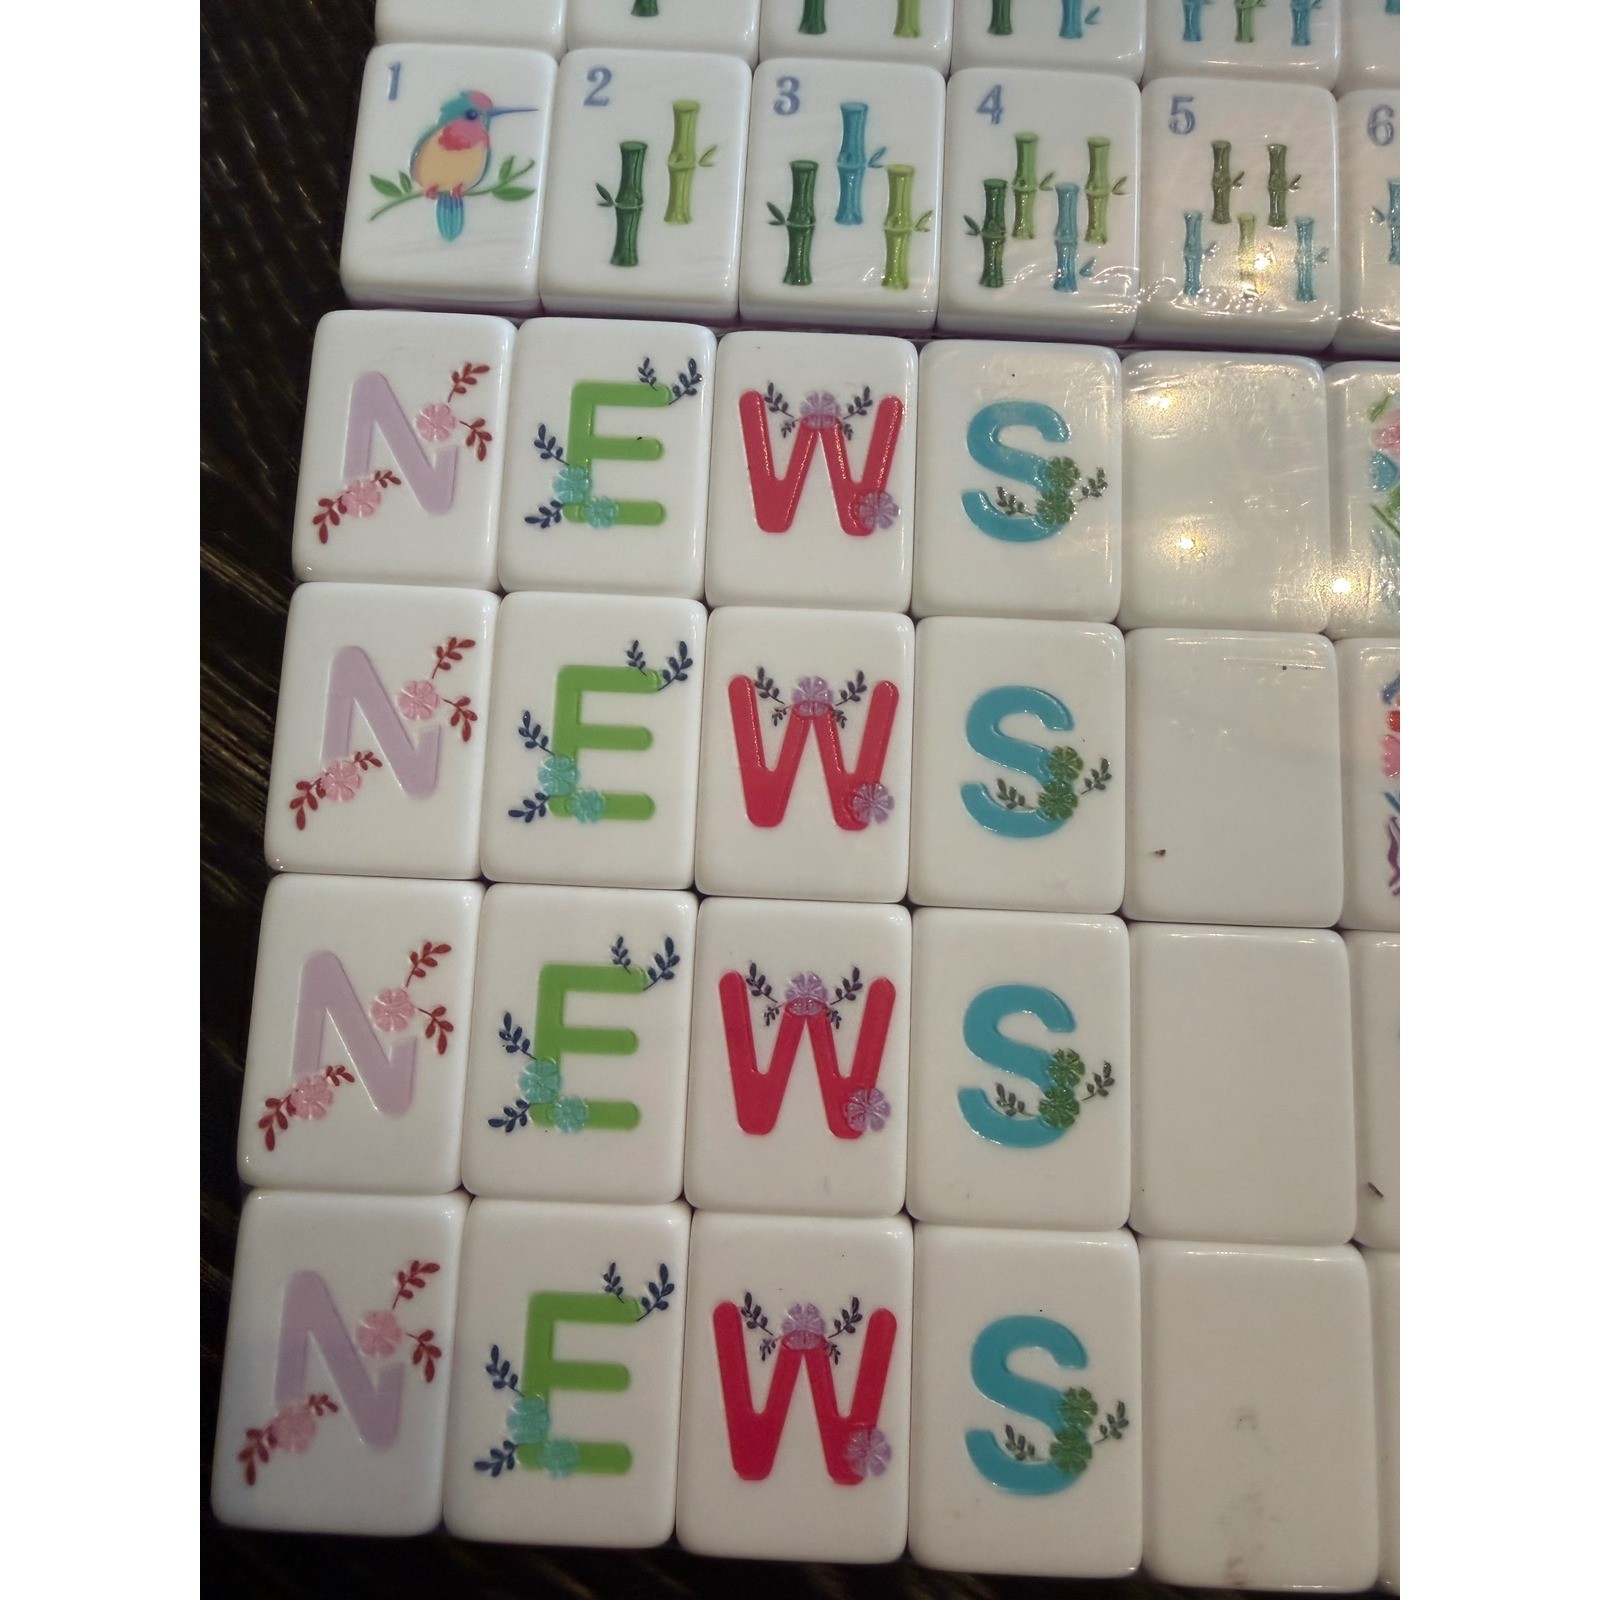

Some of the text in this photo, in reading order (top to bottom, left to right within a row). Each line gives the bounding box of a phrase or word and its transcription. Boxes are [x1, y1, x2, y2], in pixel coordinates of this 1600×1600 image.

[583, 67, 612, 107] 2
[773, 76, 800, 115] 3
[977, 85, 1004, 125] 4
[1169, 96, 1195, 134] 5
[1367, 104, 1395, 146] 6
[340, 371, 457, 515] N
[562, 381, 670, 526] E
[739, 390, 902, 536] W
[961, 401, 1075, 543] S
[320, 646, 442, 798] N
[549, 665, 664, 820] E
[728, 674, 900, 831] W
[960, 685, 1077, 838] S
[291, 950, 418, 1115] N
[528, 963, 646, 1130] E
[719, 970, 896, 1139] W
[958, 984, 1079, 1148] S
[273, 1269, 405, 1453] N
[517, 1291, 641, 1475] E
[712, 1300, 897, 1485] W
[966, 1315, 1090, 1496] S
